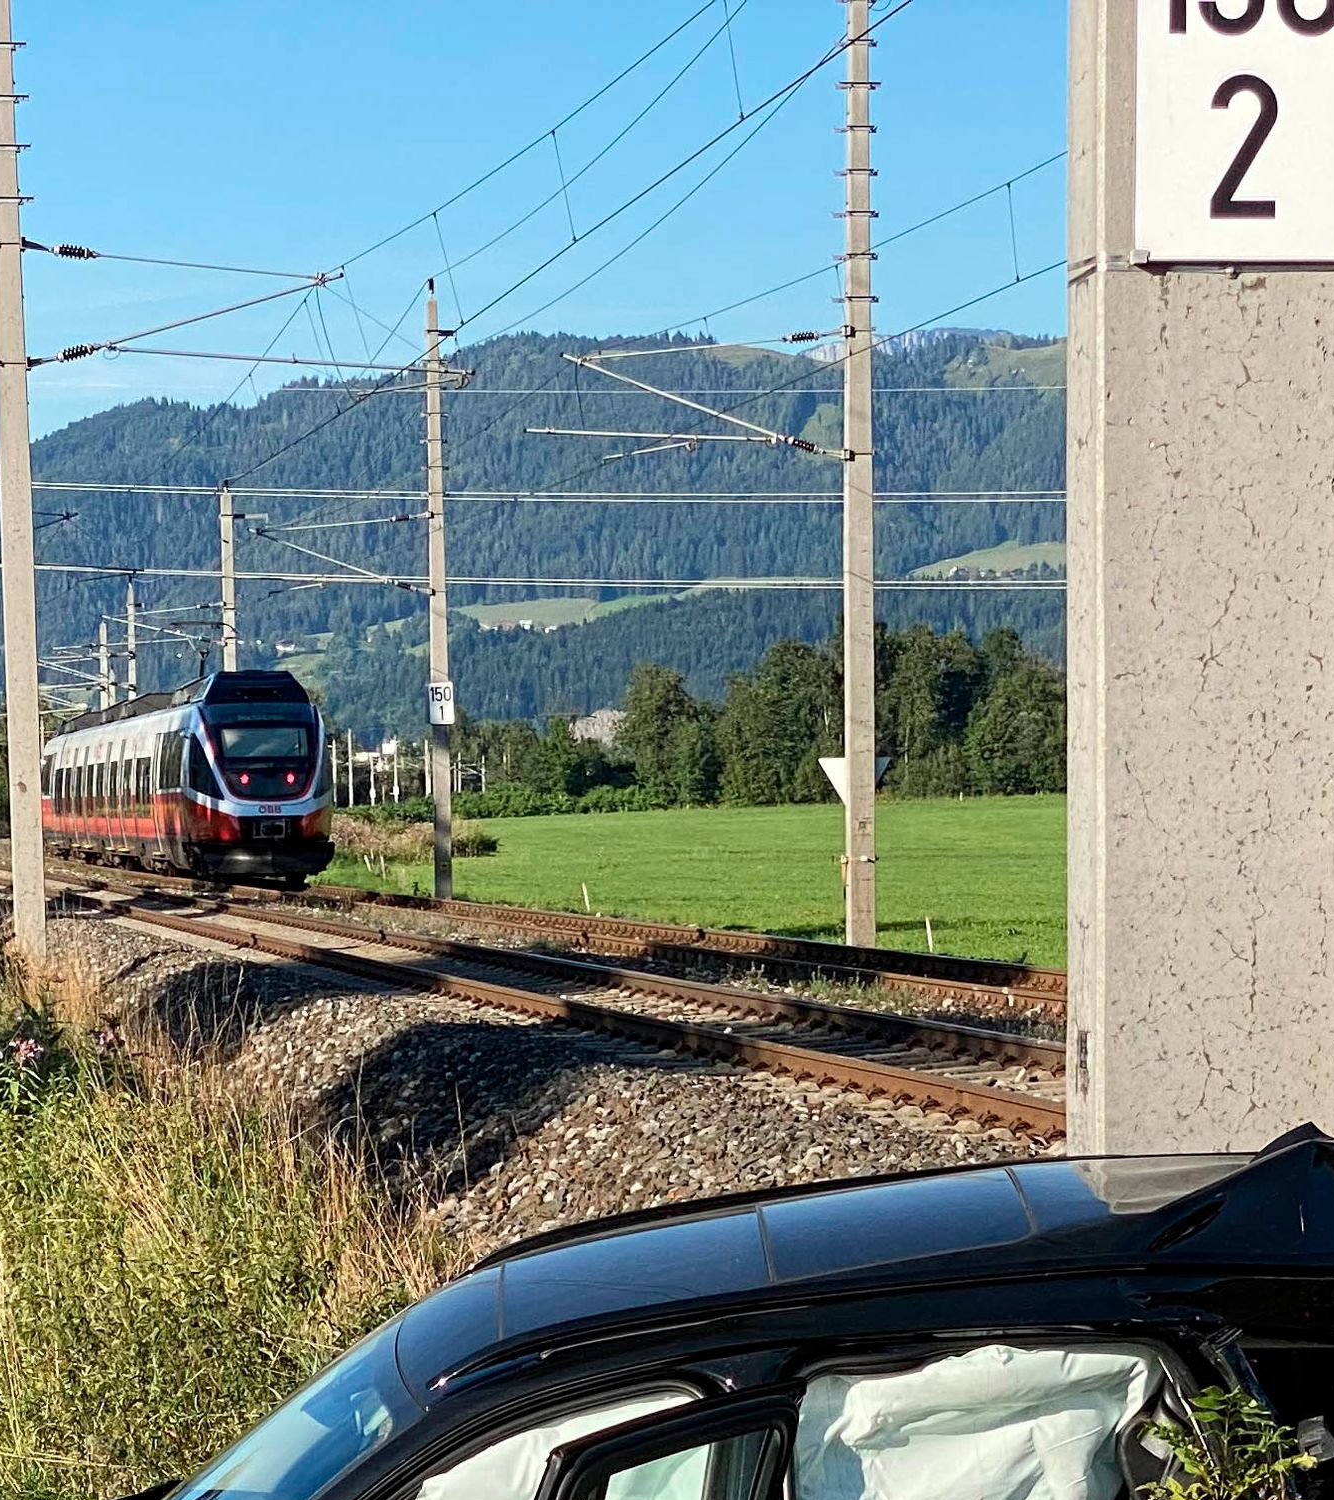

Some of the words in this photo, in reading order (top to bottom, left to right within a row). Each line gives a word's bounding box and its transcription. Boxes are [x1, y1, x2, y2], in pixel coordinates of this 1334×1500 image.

[1210, 74, 1278, 219] 2
[430, 686, 451, 702] 150
[439, 705, 444, 720] 1
